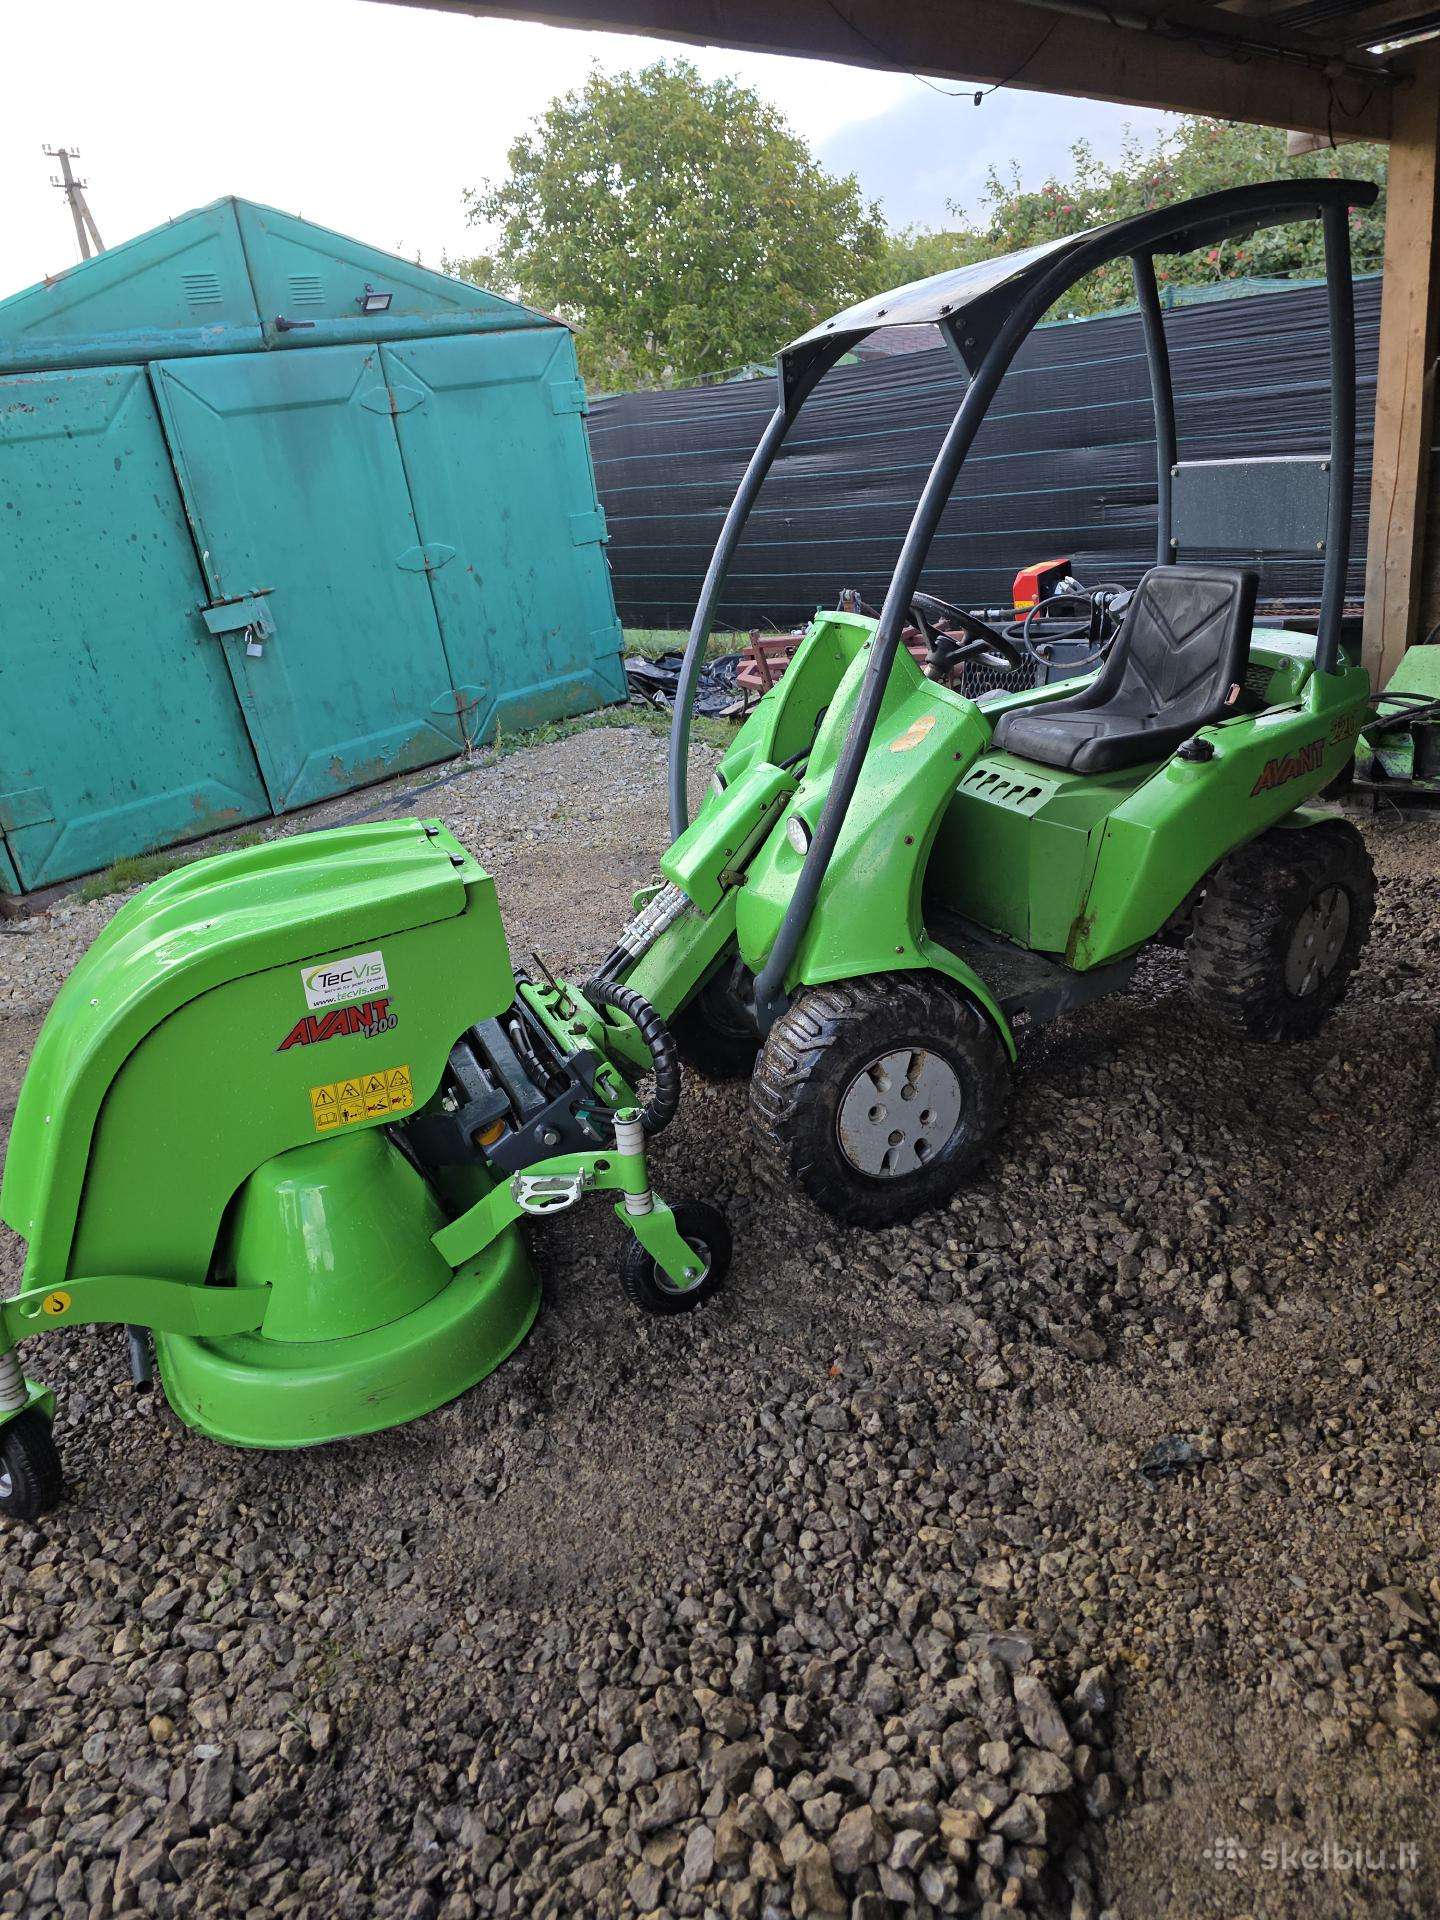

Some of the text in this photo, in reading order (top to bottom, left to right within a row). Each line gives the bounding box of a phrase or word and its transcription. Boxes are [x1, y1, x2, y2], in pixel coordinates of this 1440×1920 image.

[1250, 738, 1326, 798] AVANT
[318, 963, 382, 988] TecVis
[313, 984, 386, 1007] www.tecvis.com
[276, 998, 390, 1052] AVANT
[362, 1013, 399, 1040] 1200
